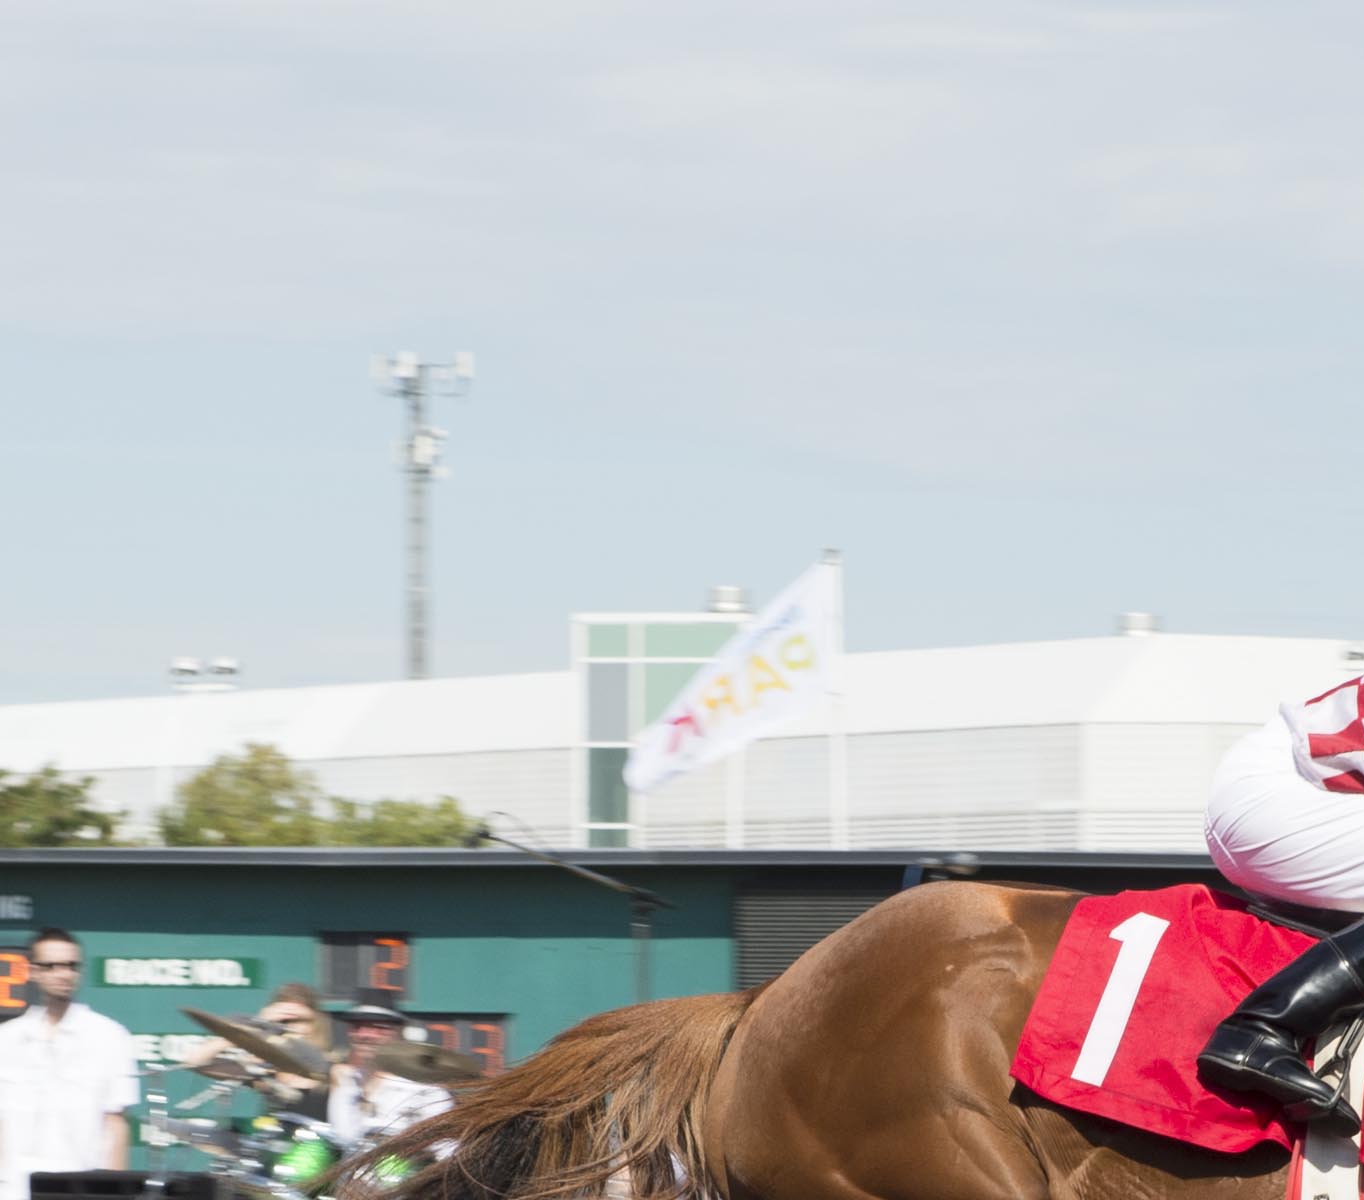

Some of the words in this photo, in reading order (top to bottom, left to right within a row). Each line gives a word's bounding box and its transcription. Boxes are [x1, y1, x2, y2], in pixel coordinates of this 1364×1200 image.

[104, 958, 190, 986] RACE
[368, 937, 410, 992] 2
[1071, 912, 1170, 1087] 1
